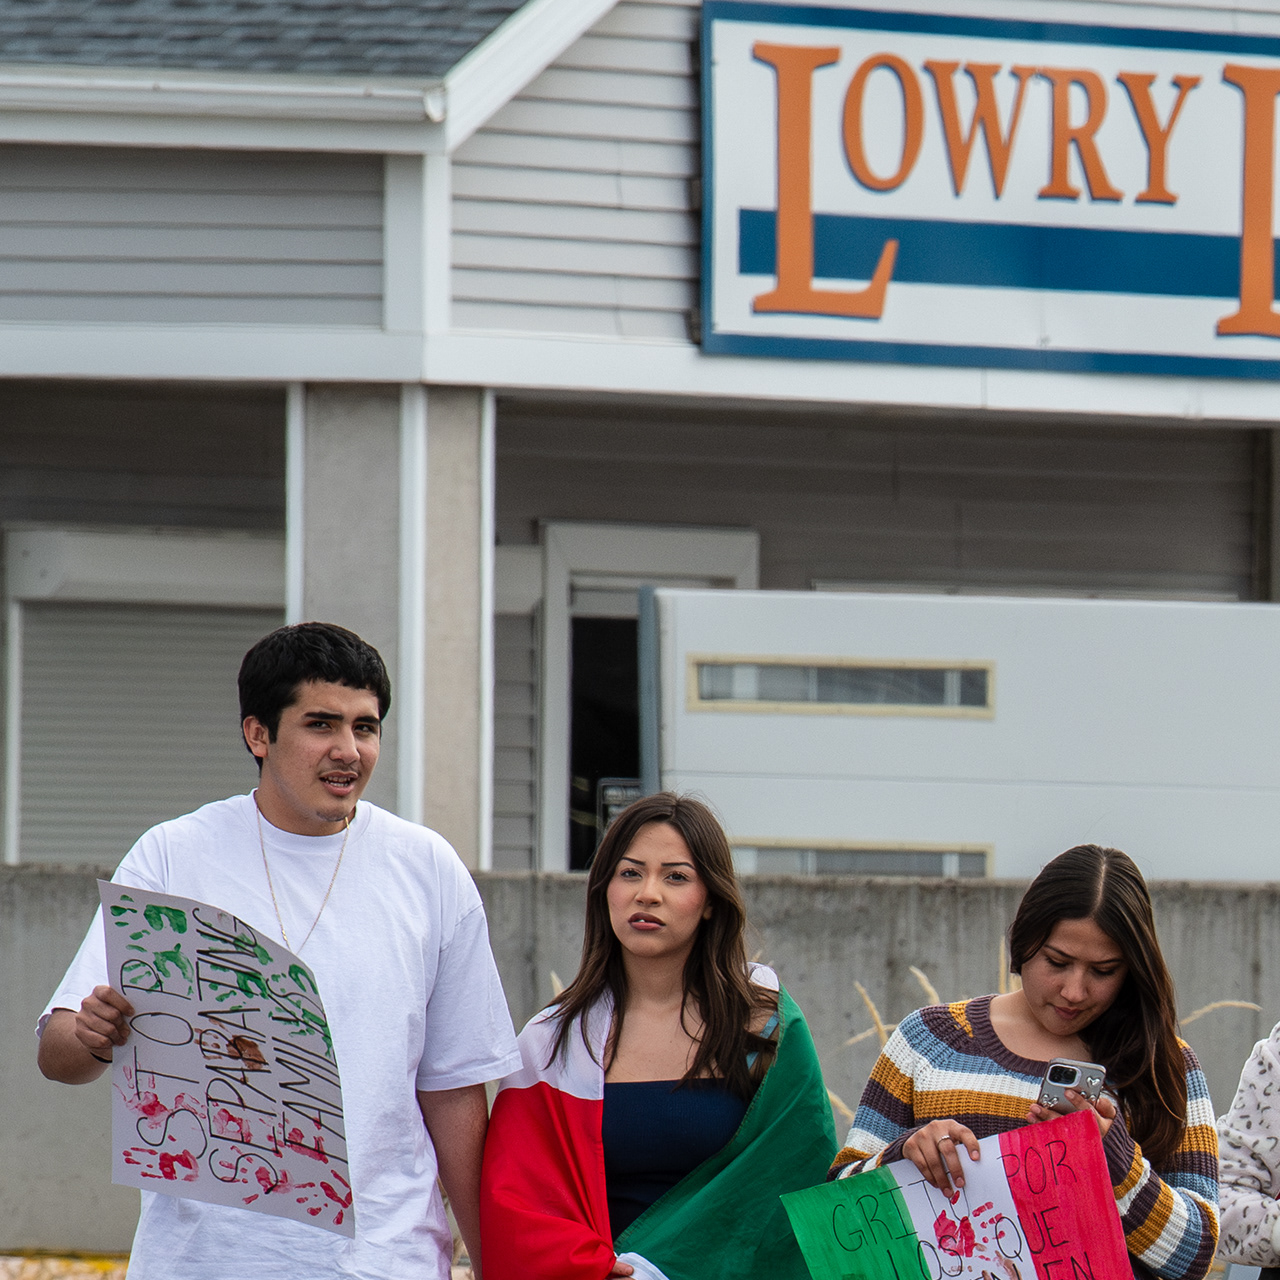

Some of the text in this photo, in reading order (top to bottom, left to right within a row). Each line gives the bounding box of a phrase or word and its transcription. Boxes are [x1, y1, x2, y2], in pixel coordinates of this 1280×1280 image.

[751, 40, 1203, 321] LOWRY
[120, 959, 207, 1159] STOP
[192, 907, 278, 1195] SEPARATING
[995, 1206, 1070, 1263] QUE
[996, 1140, 1077, 1196] POR
